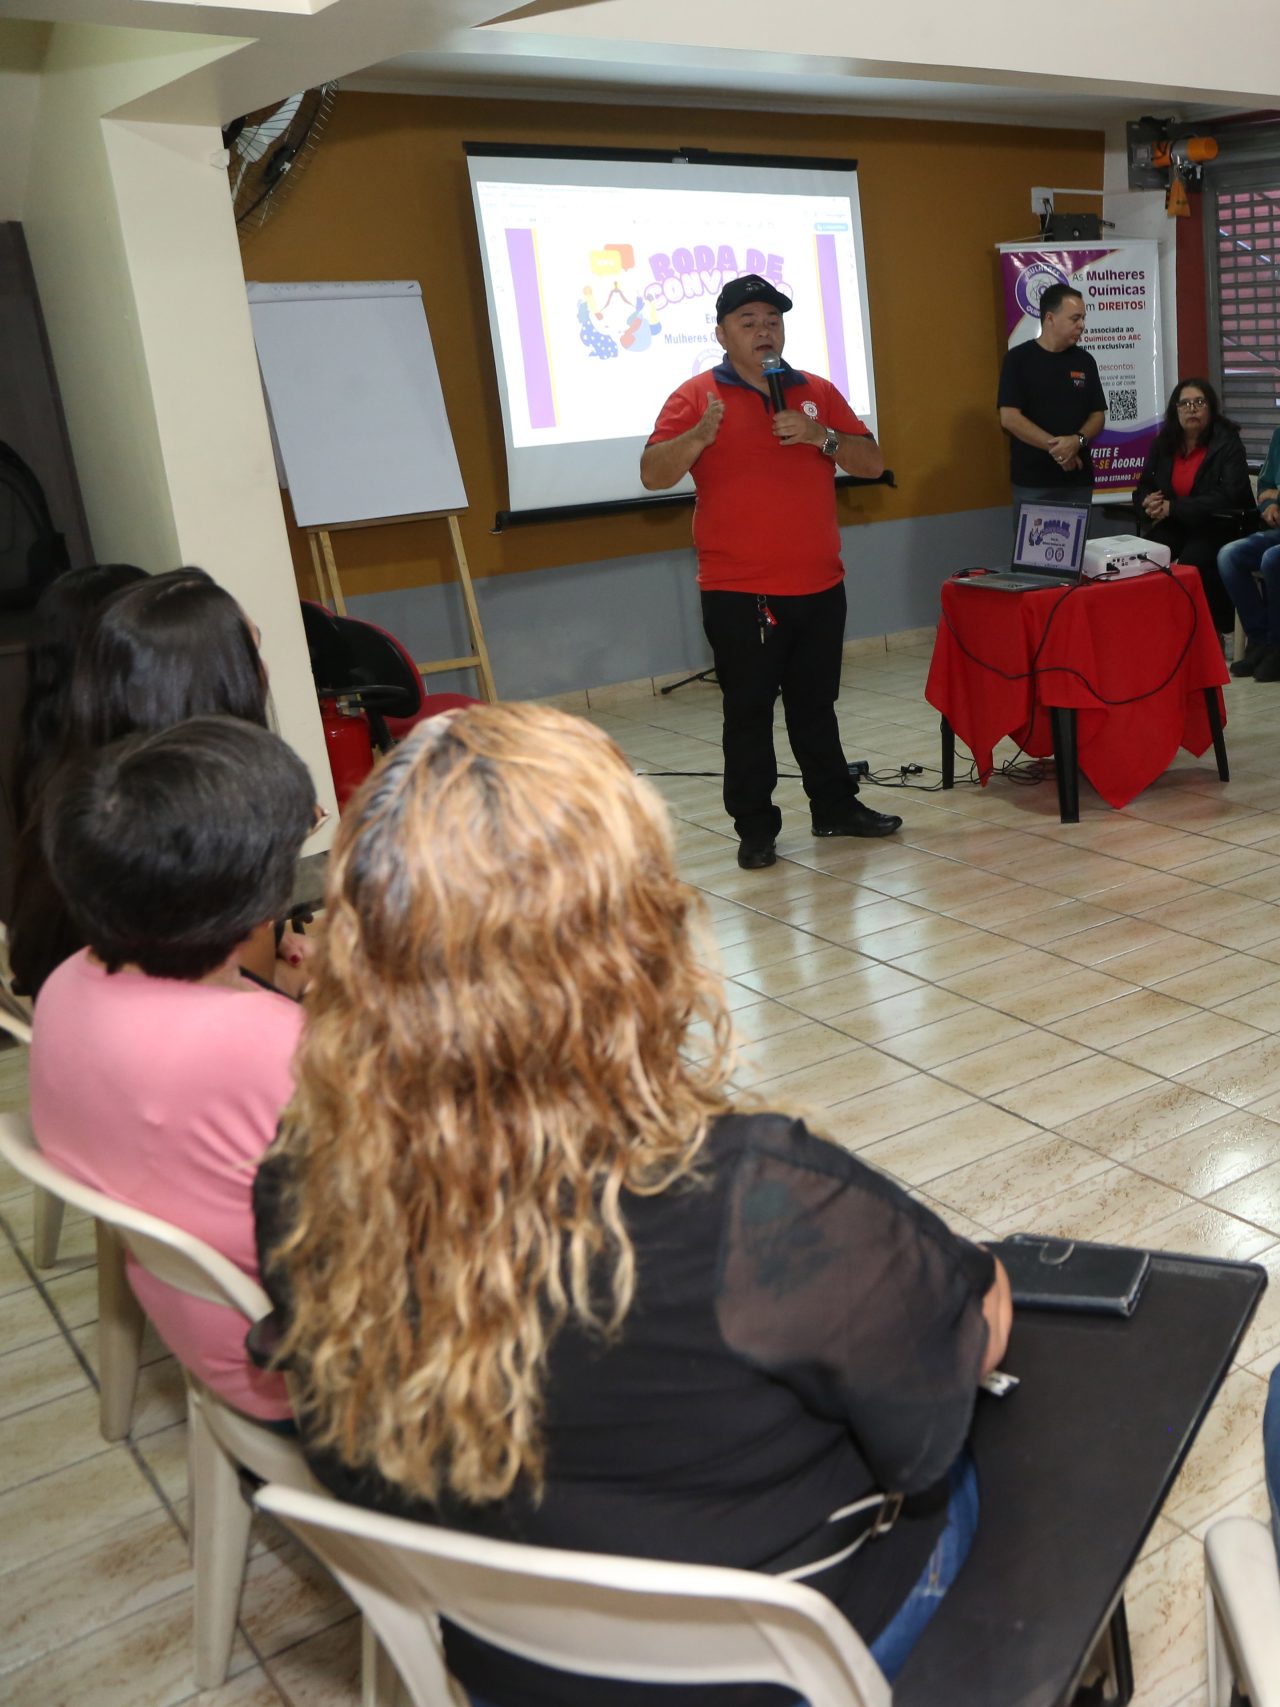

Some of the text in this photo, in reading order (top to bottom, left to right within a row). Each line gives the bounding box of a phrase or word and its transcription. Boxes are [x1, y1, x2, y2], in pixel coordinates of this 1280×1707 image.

[648, 245, 785, 281] RODA DE
[1086, 270, 1145, 281] Mulheres
[644, 267, 793, 311] CONV
[1088, 284, 1146, 297] Químicas
[1098, 300, 1146, 311] DIREITOS!
[1090, 326, 1124, 334] associada
[664, 333, 708, 344] Mulheres
[1111, 456, 1145, 470] AGORA!
